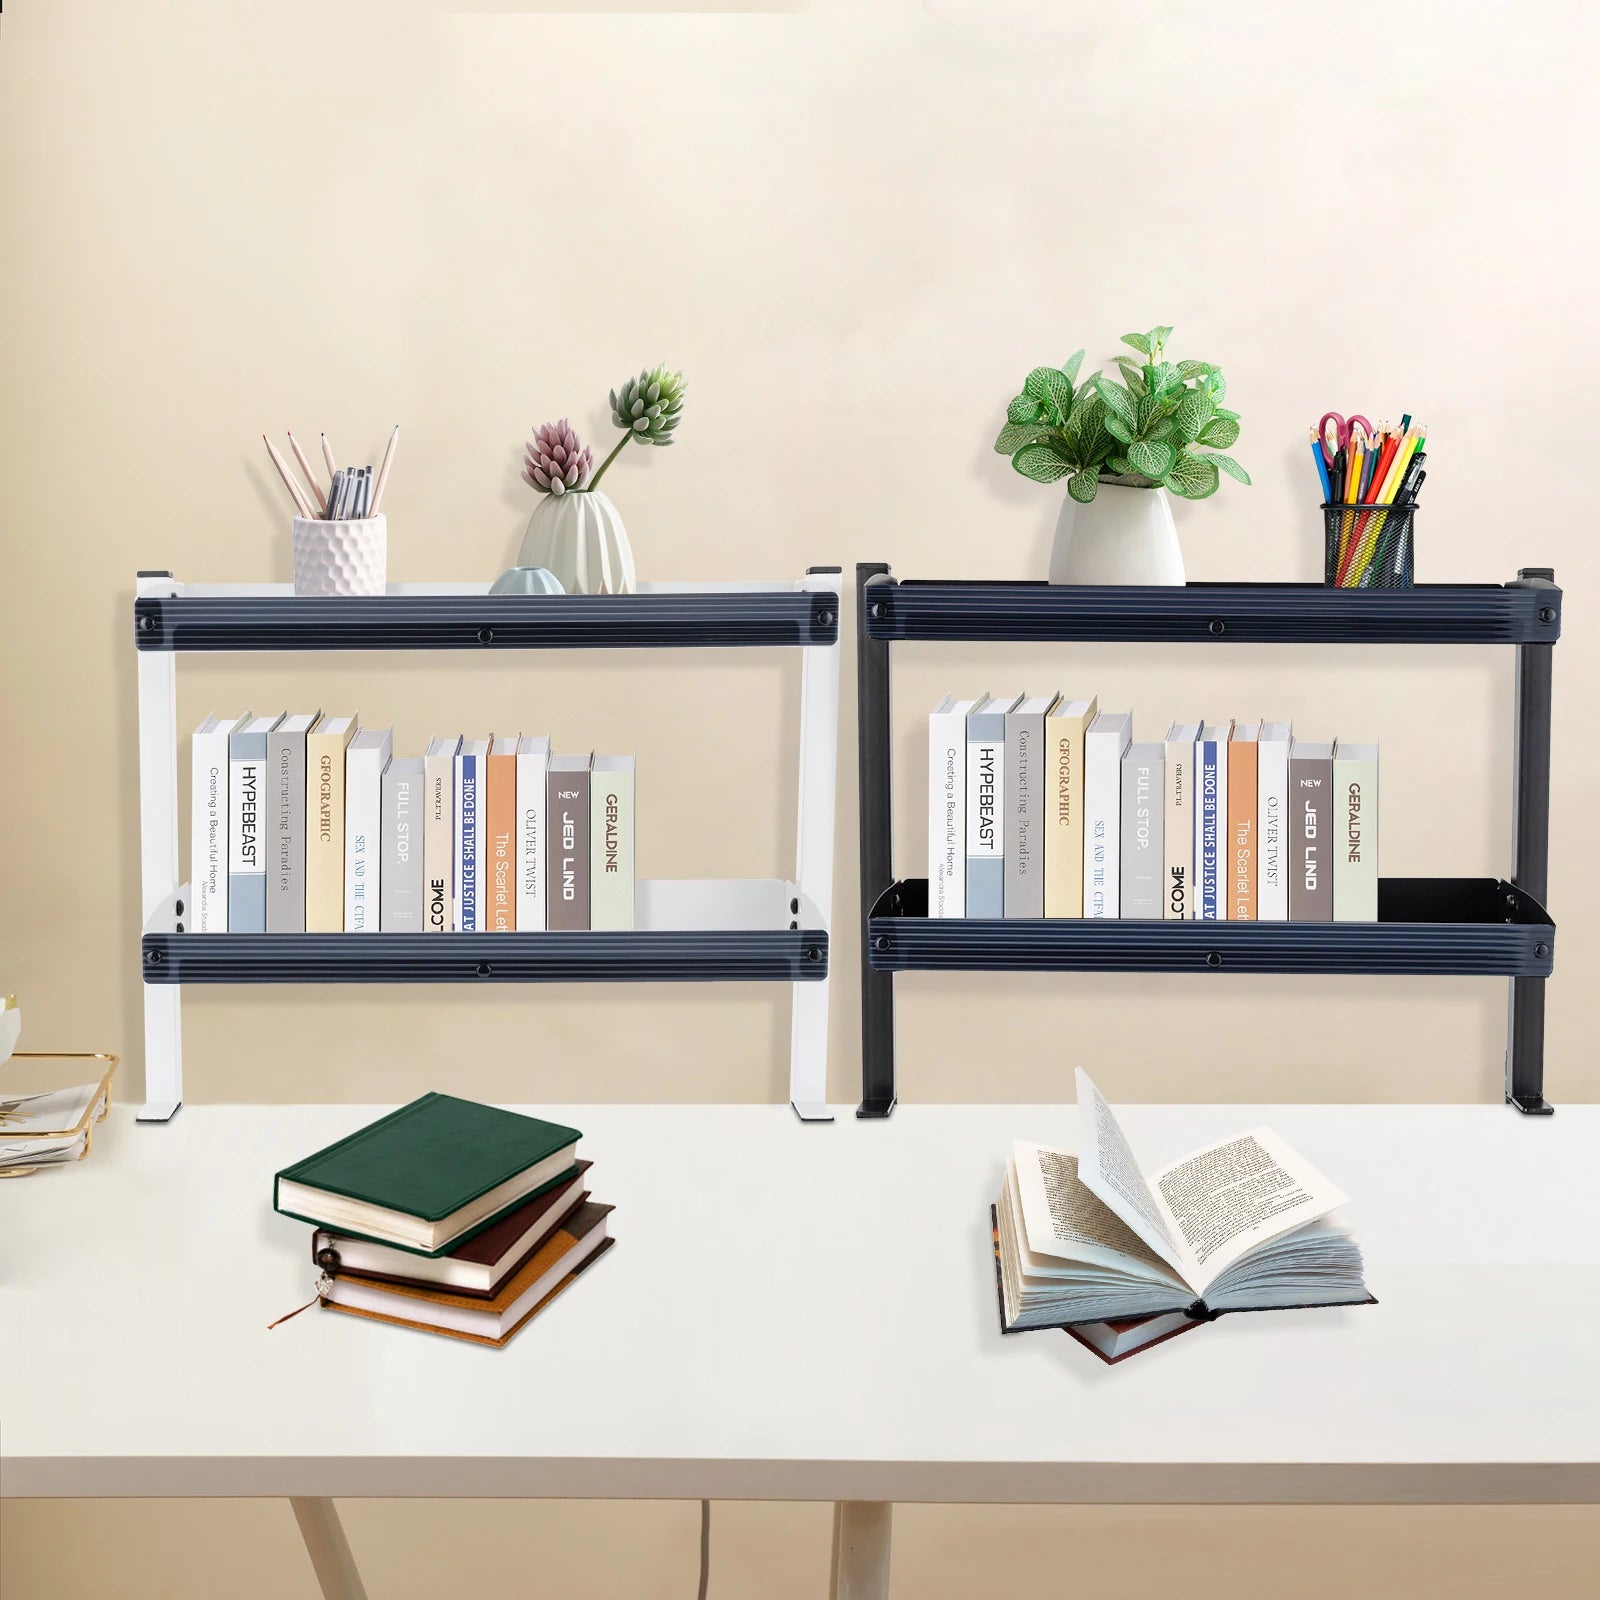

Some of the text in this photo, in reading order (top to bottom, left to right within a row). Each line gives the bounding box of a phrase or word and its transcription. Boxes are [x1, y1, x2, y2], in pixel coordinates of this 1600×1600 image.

[207, 767, 219, 808] Creating
[945, 748, 957, 791] Creating
[1137, 767, 1149, 804] FULL
[1204, 764, 1216, 795] DONE
[1300, 779, 1322, 787] NEW
[397, 782, 409, 819] FULL
[463, 778, 475, 807] DONE
[558, 791, 580, 799] NEW
[979, 748, 994, 850] HYPEBEAST
[1018, 730, 1030, 875] Constructing Paradies
[1204, 797, 1216, 810] BE
[242, 766, 256, 867] HYPEBEAST
[280, 748, 292, 891] Constructing Paradies
[463, 811, 475, 822] BE
[605, 793, 618, 872] GERALDINE
[946, 802, 957, 845] Beautiful
[1094, 820, 1105, 838] SEX
[1204, 812, 1216, 847] SHALL
[1236, 820, 1250, 845] The
[1348, 782, 1361, 863] GERALDINE
[209, 819, 219, 862] Beautiful
[355, 835, 365, 853] SEX
[463, 823, 475, 859] SHALL
[496, 833, 509, 857] The
[526, 809, 537, 898] OLIVER TWIST
[562, 811, 575, 901] JED LIND
[1094, 844, 1104, 862] AND
[1267, 796, 1278, 887] OLIVER TWIST
[1304, 800, 1317, 890] JED LIND
[209, 864, 218, 894] Home
[355, 859, 365, 877] AND
[946, 847, 956, 877] Home
[1093, 868, 1104, 886] THE
[1204, 852, 1216, 900] JUSTICE
[1236, 849, 1250, 895] Scarlet
[354, 882, 365, 900] THE
[463, 864, 475, 912] JUSTICE
[496, 860, 509, 906] Scarlet
